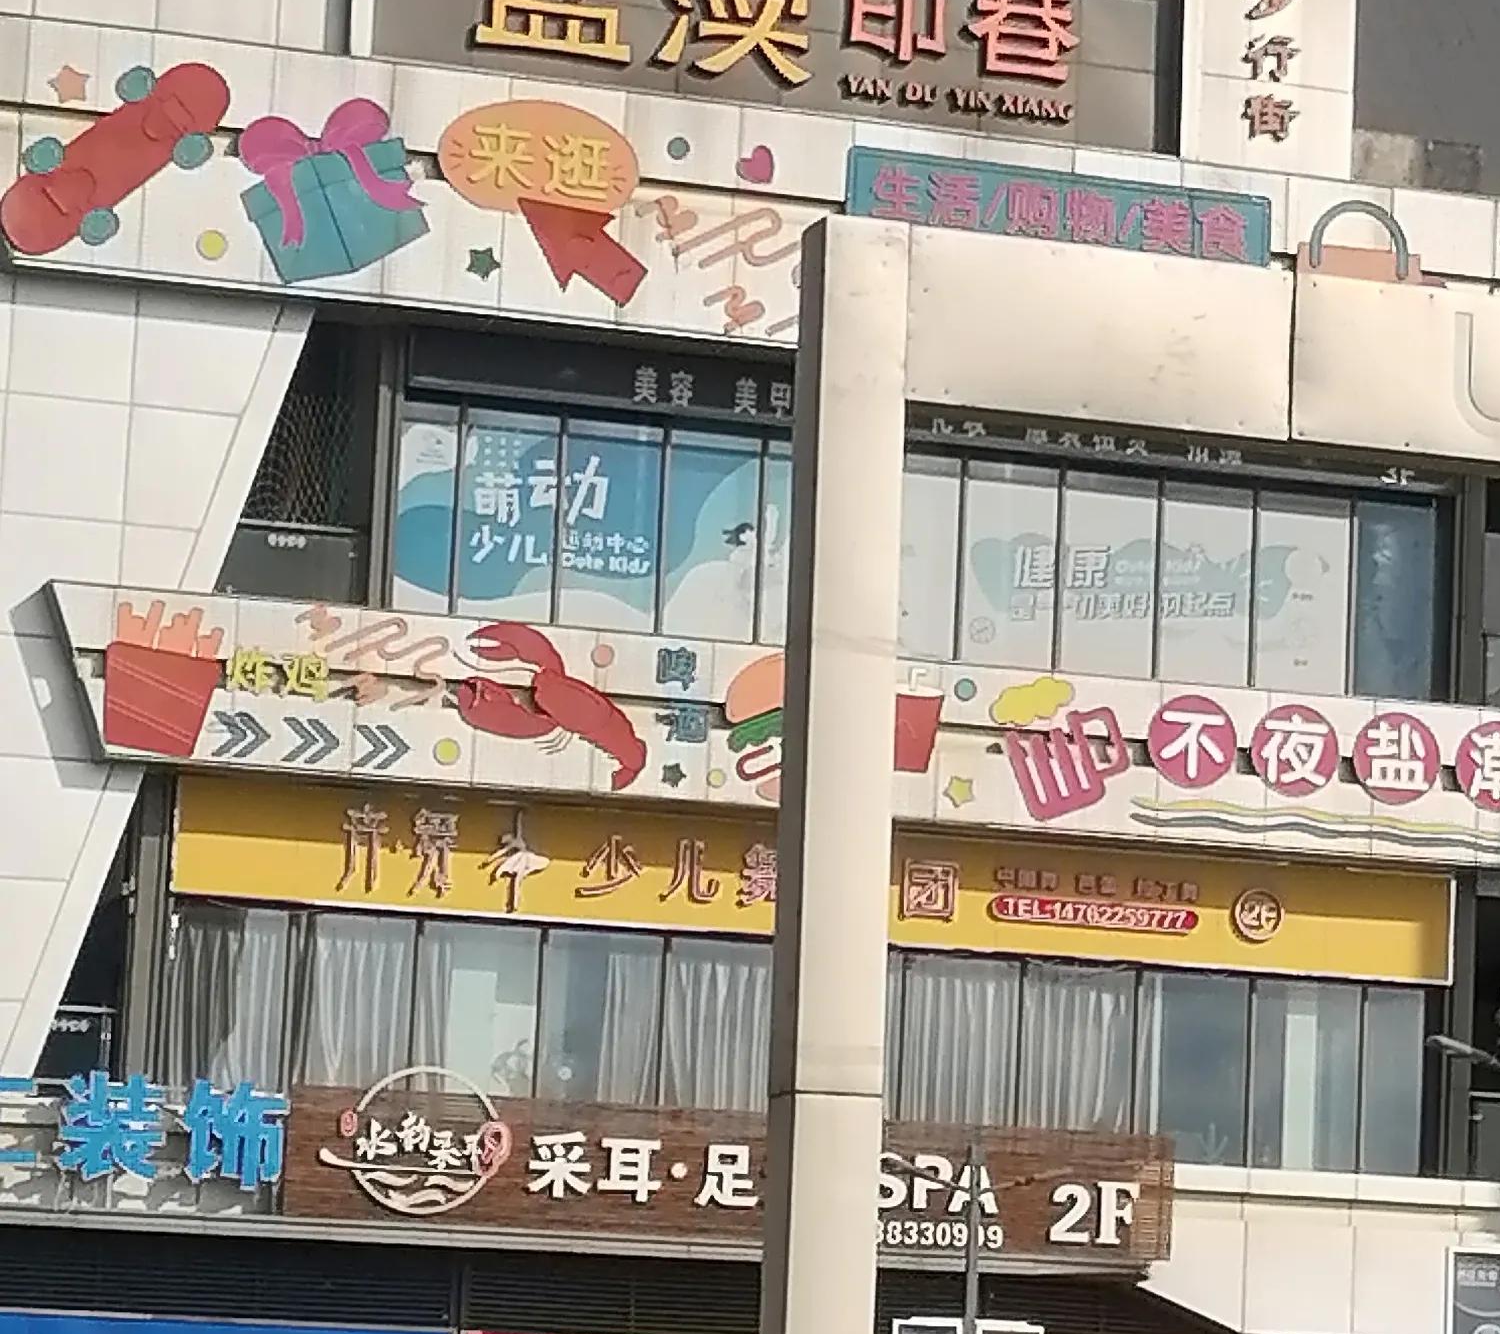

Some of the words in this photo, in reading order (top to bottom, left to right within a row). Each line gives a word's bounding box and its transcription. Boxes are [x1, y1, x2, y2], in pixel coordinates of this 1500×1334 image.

[472, 123, 616, 202] 来逛
[633, 366, 693, 407] 美容
[1013, 544, 1111, 588] 健康
[1050, 1180, 1141, 1245] 2F
